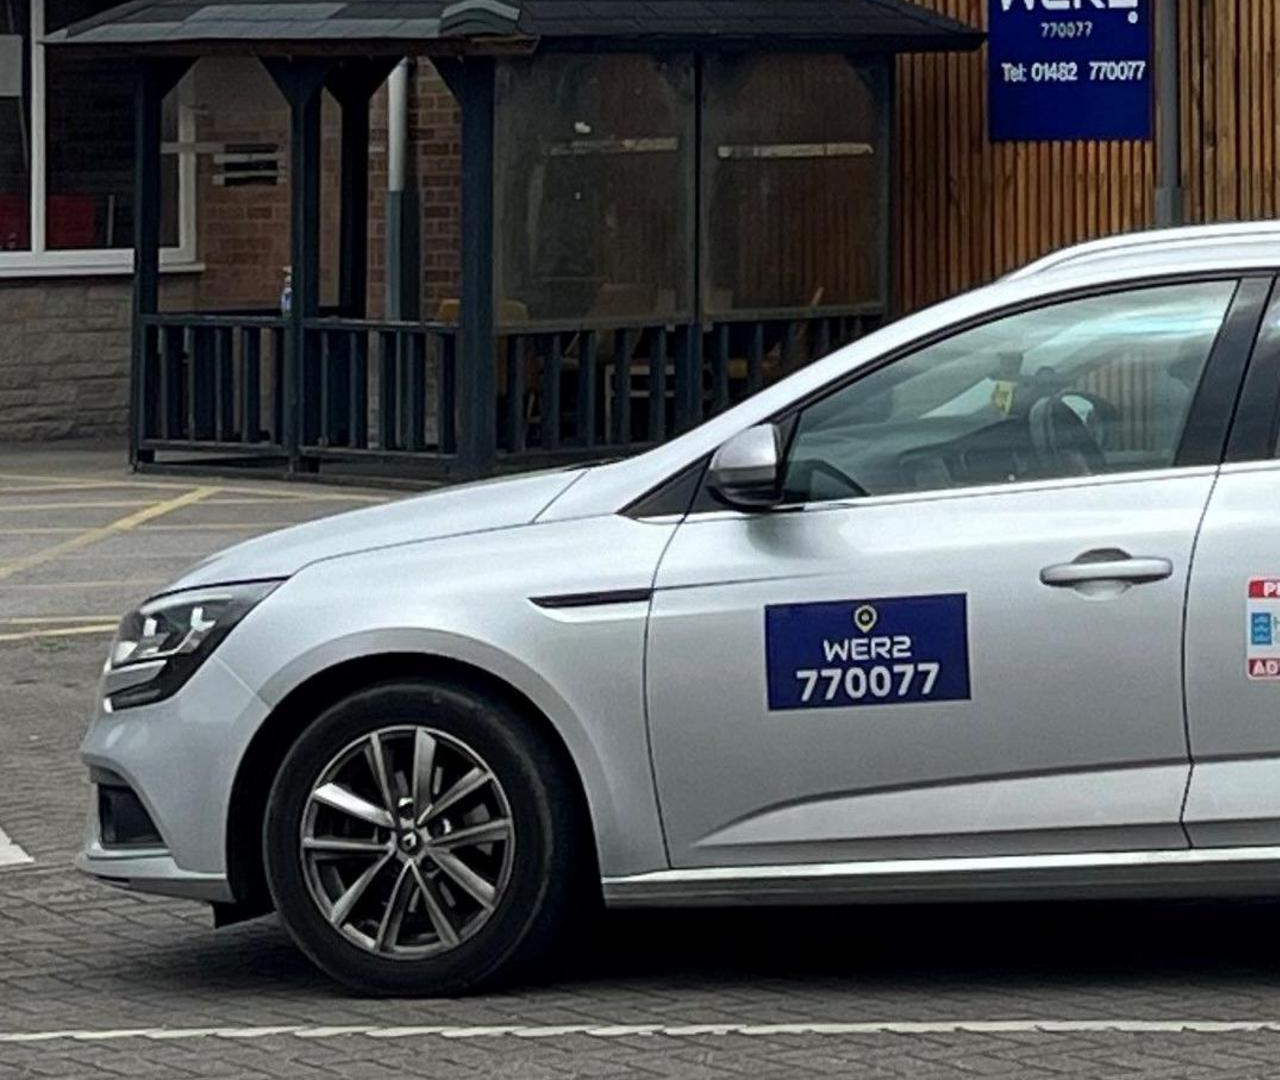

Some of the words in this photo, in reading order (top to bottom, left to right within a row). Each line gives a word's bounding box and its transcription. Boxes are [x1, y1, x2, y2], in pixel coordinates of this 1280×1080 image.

[1041, 21, 1093, 38] 770077
[1031, 63, 1078, 81] 01482
[1089, 60, 1146, 80] 770077
[823, 635, 912, 662] WER2
[796, 662, 939, 702] 770077
